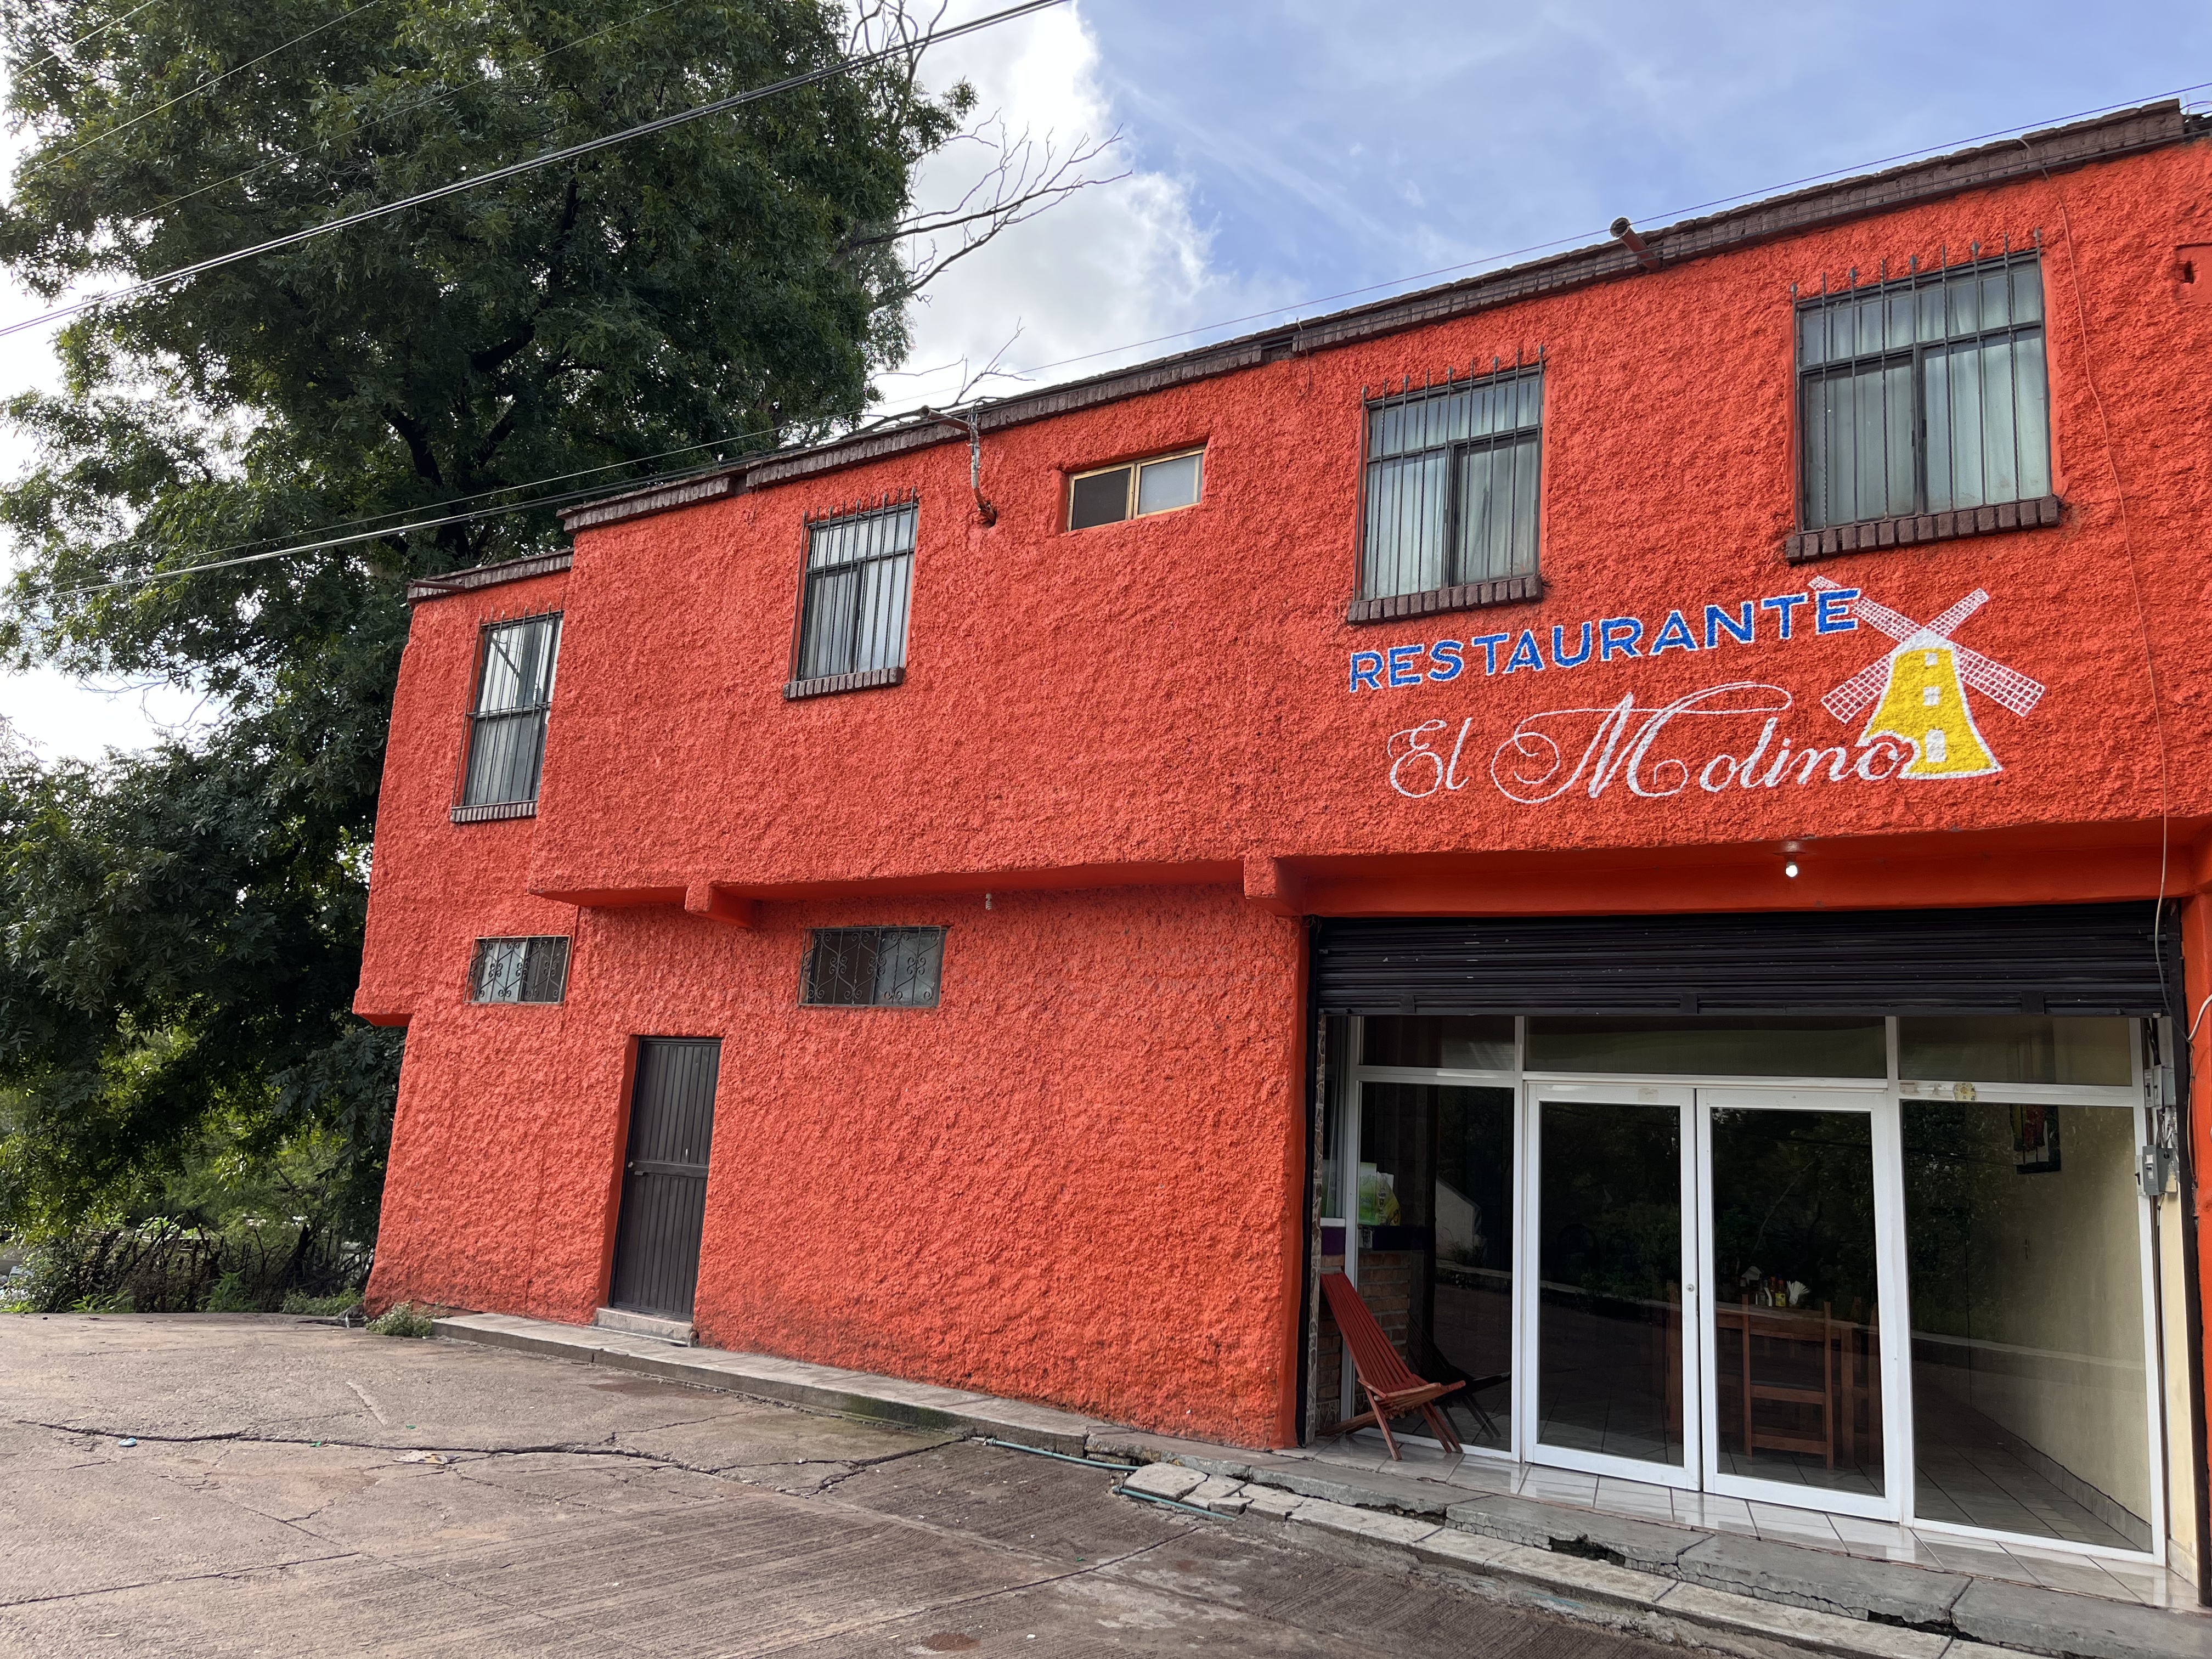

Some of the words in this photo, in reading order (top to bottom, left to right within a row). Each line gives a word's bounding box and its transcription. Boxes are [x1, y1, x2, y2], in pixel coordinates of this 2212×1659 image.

[1349, 588, 1861, 692] RESTAURANTE
[1387, 717, 1471, 799] El
[1491, 681, 1907, 804] Molino
